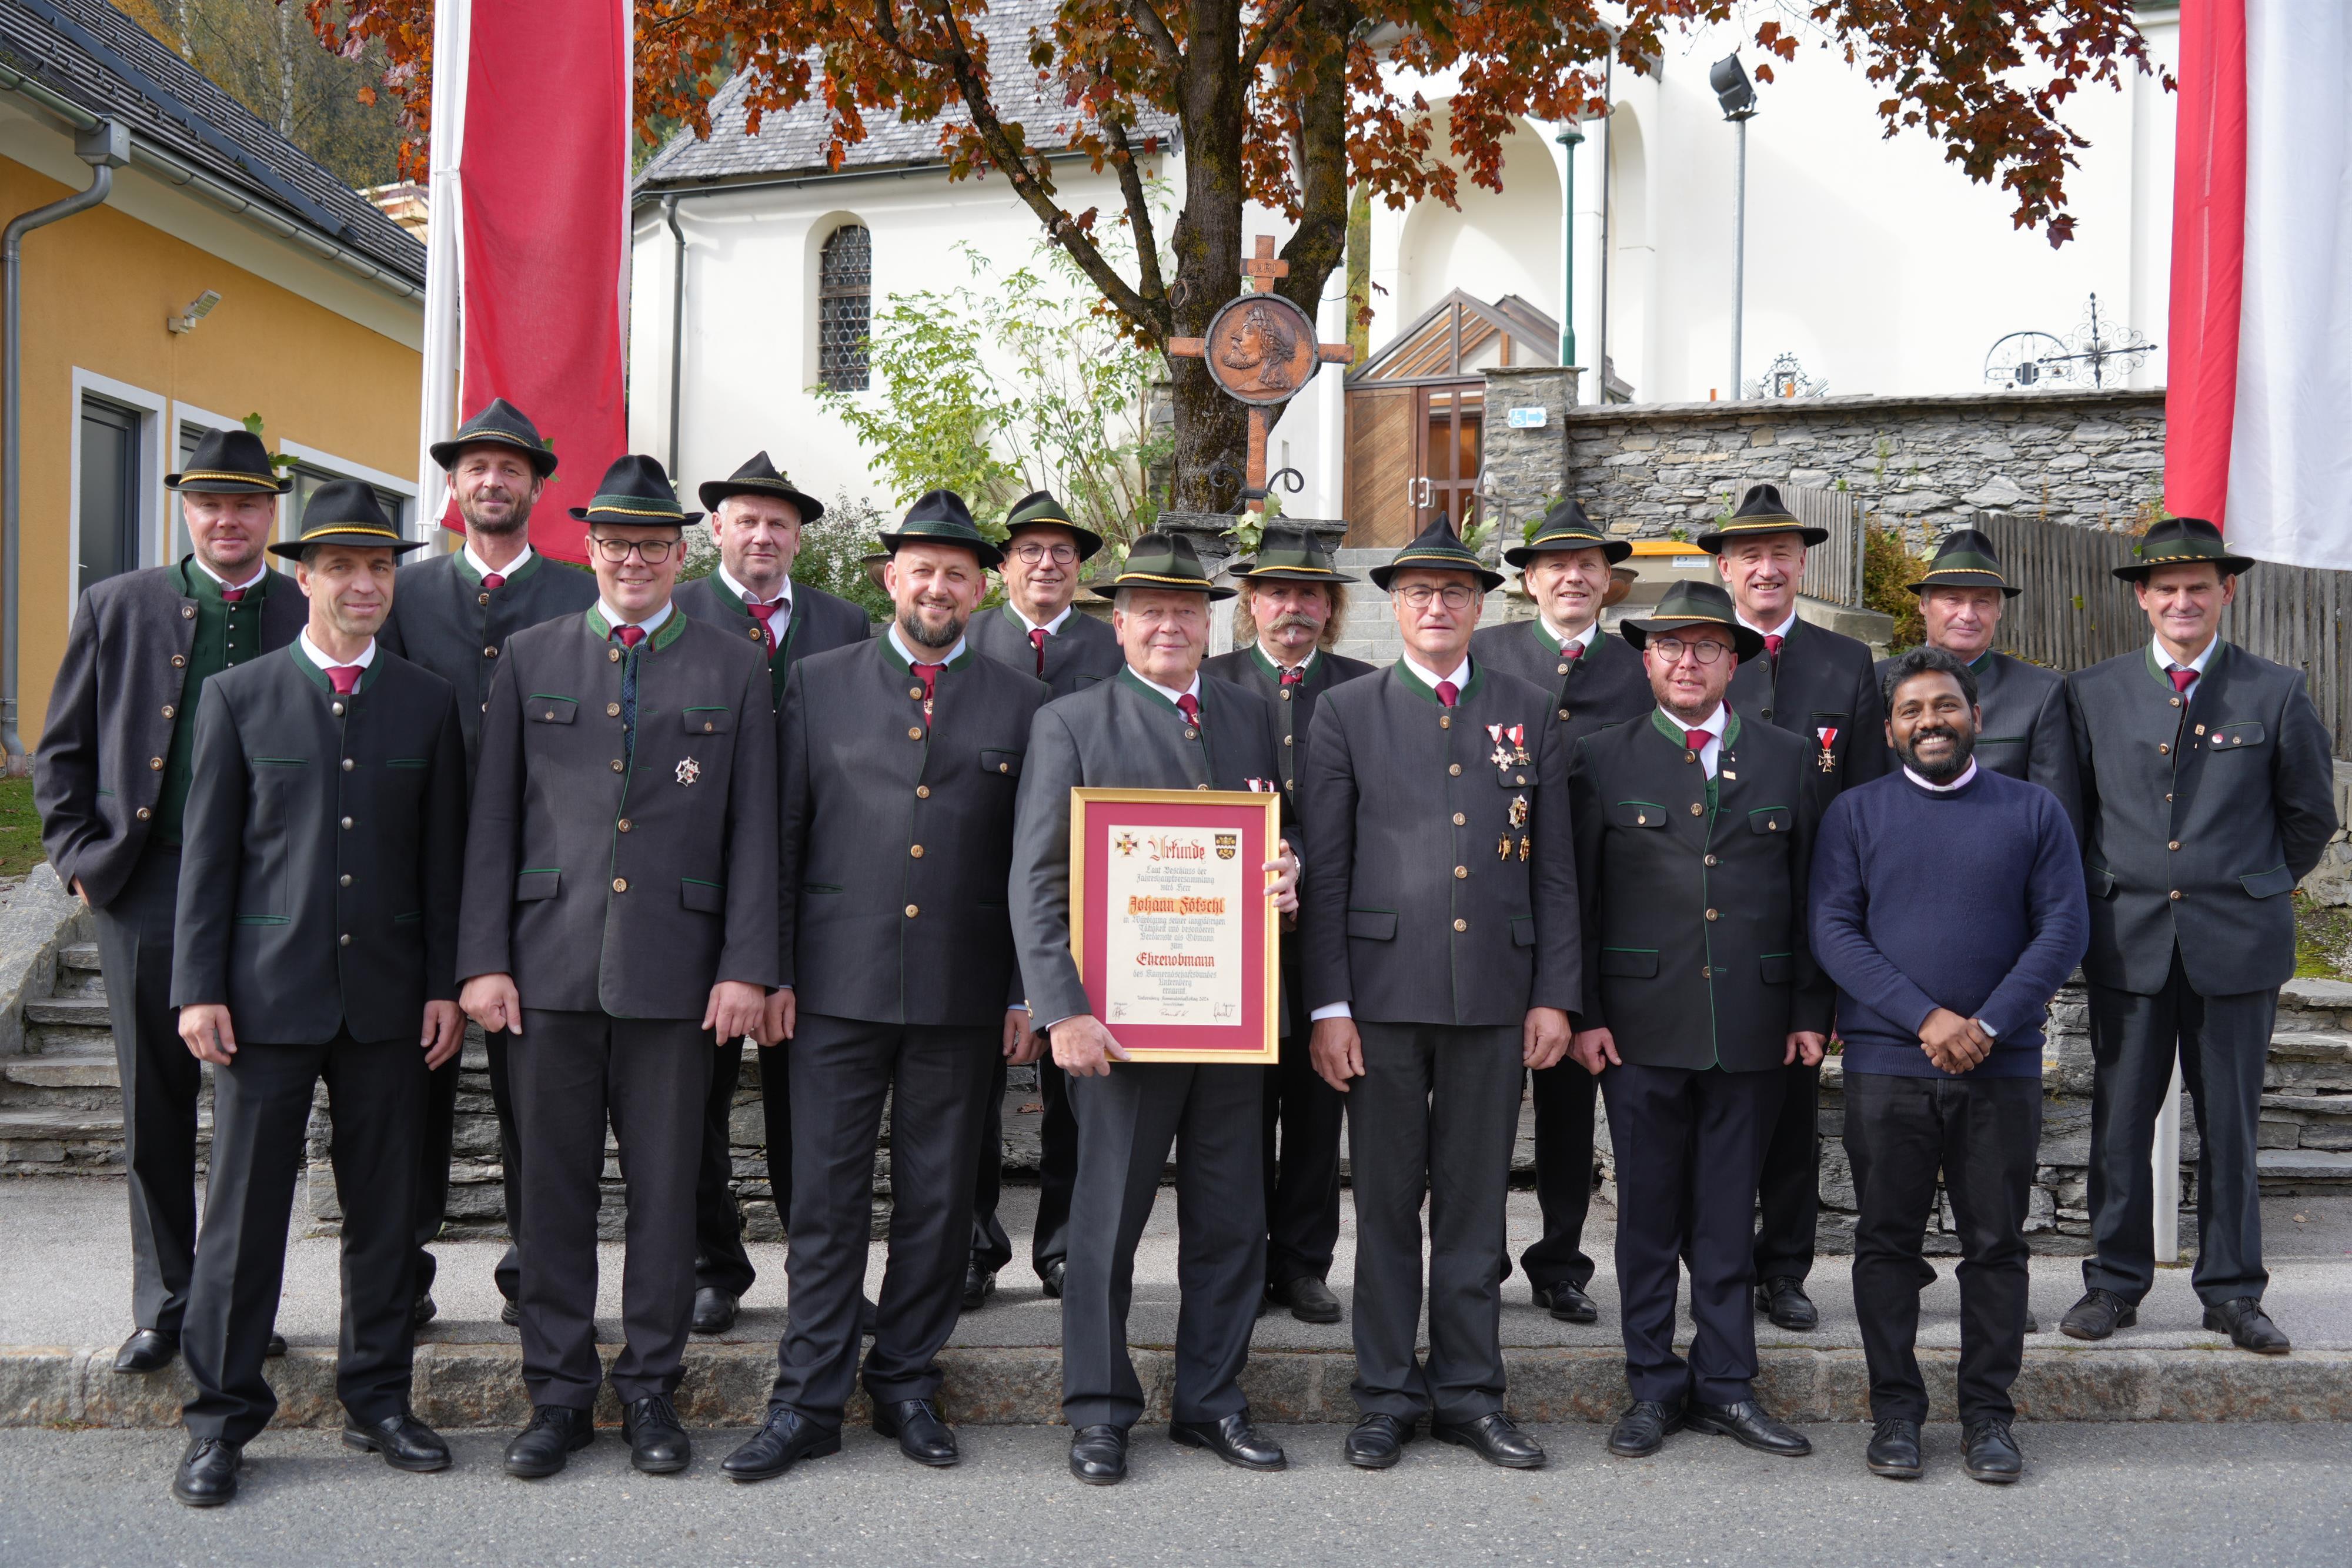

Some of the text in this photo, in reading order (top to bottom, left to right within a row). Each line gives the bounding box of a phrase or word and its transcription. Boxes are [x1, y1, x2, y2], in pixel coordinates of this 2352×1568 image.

[1148, 835, 1206, 864] Urkunde
[1145, 865, 1207, 875] Laut Beschluss der
[1137, 874, 1215, 885] Jahreshauptversammlung
[1176, 884, 1191, 892] Herr
[1130, 895, 1174, 914] Johann
[1132, 916, 1167, 925] Würdigung
[1188, 917, 1225, 927] langjährigen
[1138, 924, 1166, 933] Tätigkeit
[1181, 925, 1215, 934] besonderen
[1186, 934, 1214, 942] Obmann
[1136, 952, 1215, 967] Ehrenobmann
